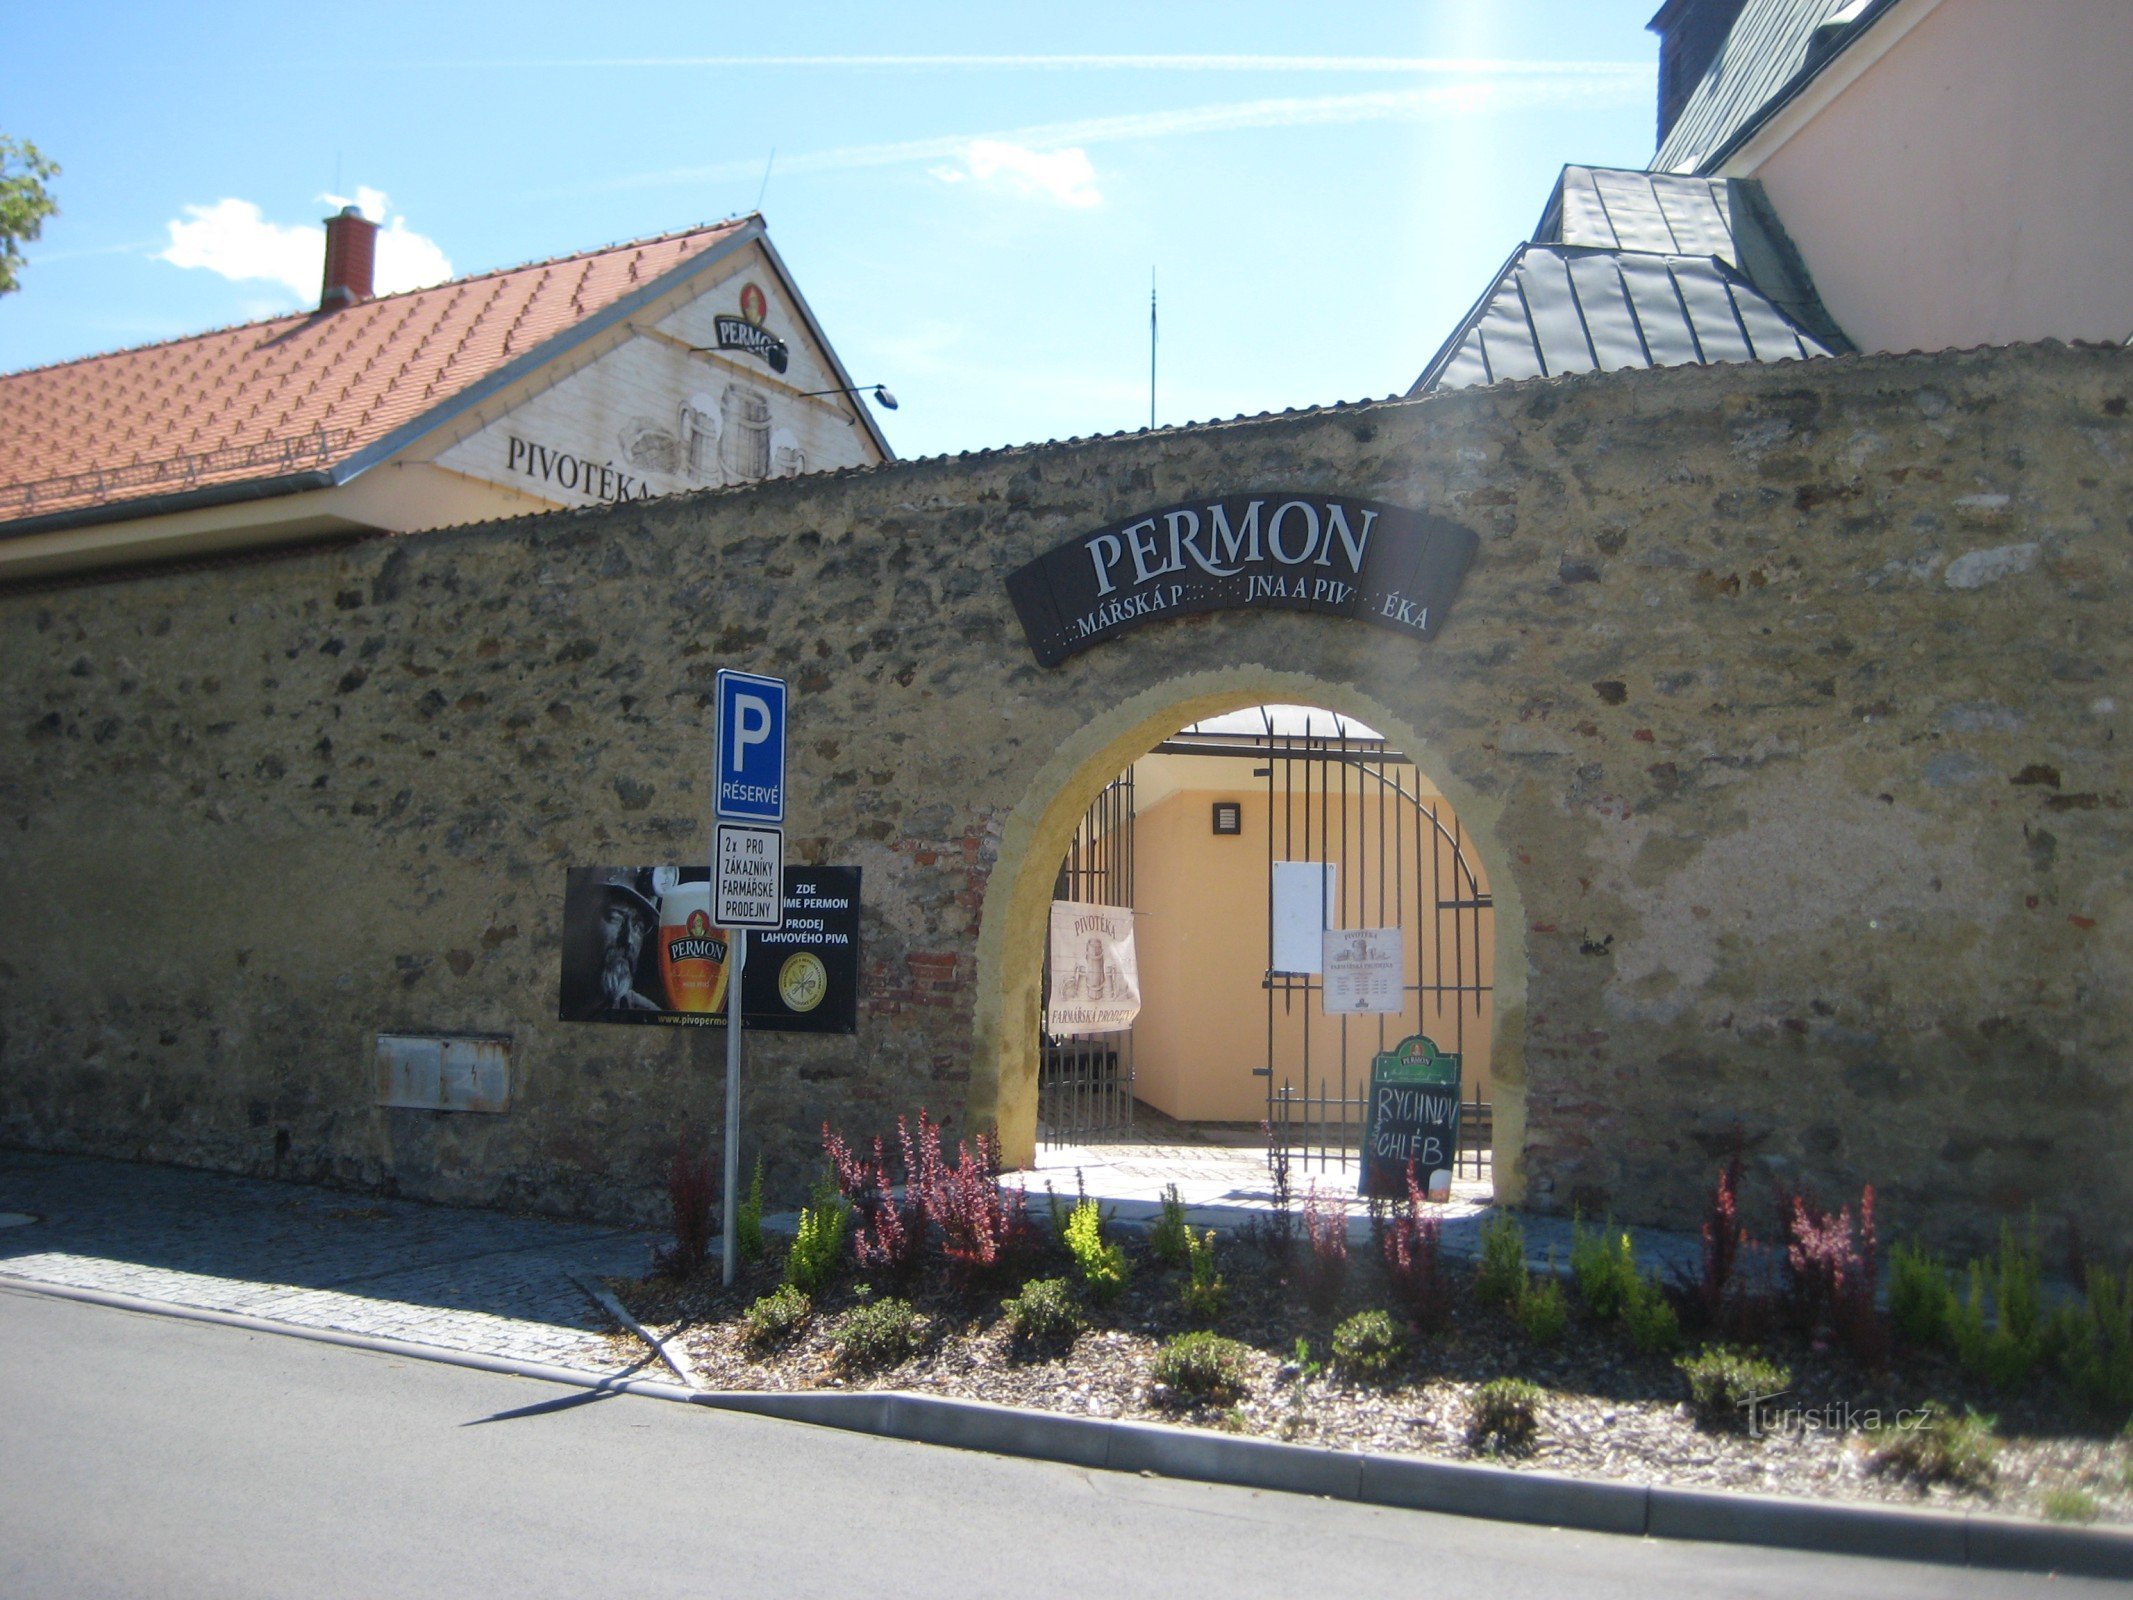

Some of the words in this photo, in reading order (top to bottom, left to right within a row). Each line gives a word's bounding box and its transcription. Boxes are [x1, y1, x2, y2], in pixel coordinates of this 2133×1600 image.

[720, 321, 777, 358] PERMO
[1084, 501, 1378, 597] PERMON
[1291, 577, 1307, 598] A
[733, 693, 771, 772] P
[722, 780, 778, 805] RÉSERVÉ
[725, 837, 737, 852] 2x
[746, 838, 763, 855] PRO
[725, 855, 774, 877] ZÁKAZNÍKY
[722, 876, 774, 898] FARMÁŘSKÉ
[796, 884, 817, 894] ZDE
[725, 901, 770, 918] PRODEJNY
[783, 896, 802, 908] ÍME
[803, 898, 849, 909] PERMON
[785, 919, 824, 931] PRODEJ
[1074, 913, 1116, 940] PIVOTÉKA
[761, 930, 823, 944] LAHVOVÉHO
[825, 933, 849, 944] PIVA
[671, 940, 725, 959] PERMON
[658, 1015, 729, 1027] www.pivopermo
[1052, 1006, 1096, 1024] FARMÁŘSKÁ
[1377, 1127, 1443, 1165] CHLÉB
